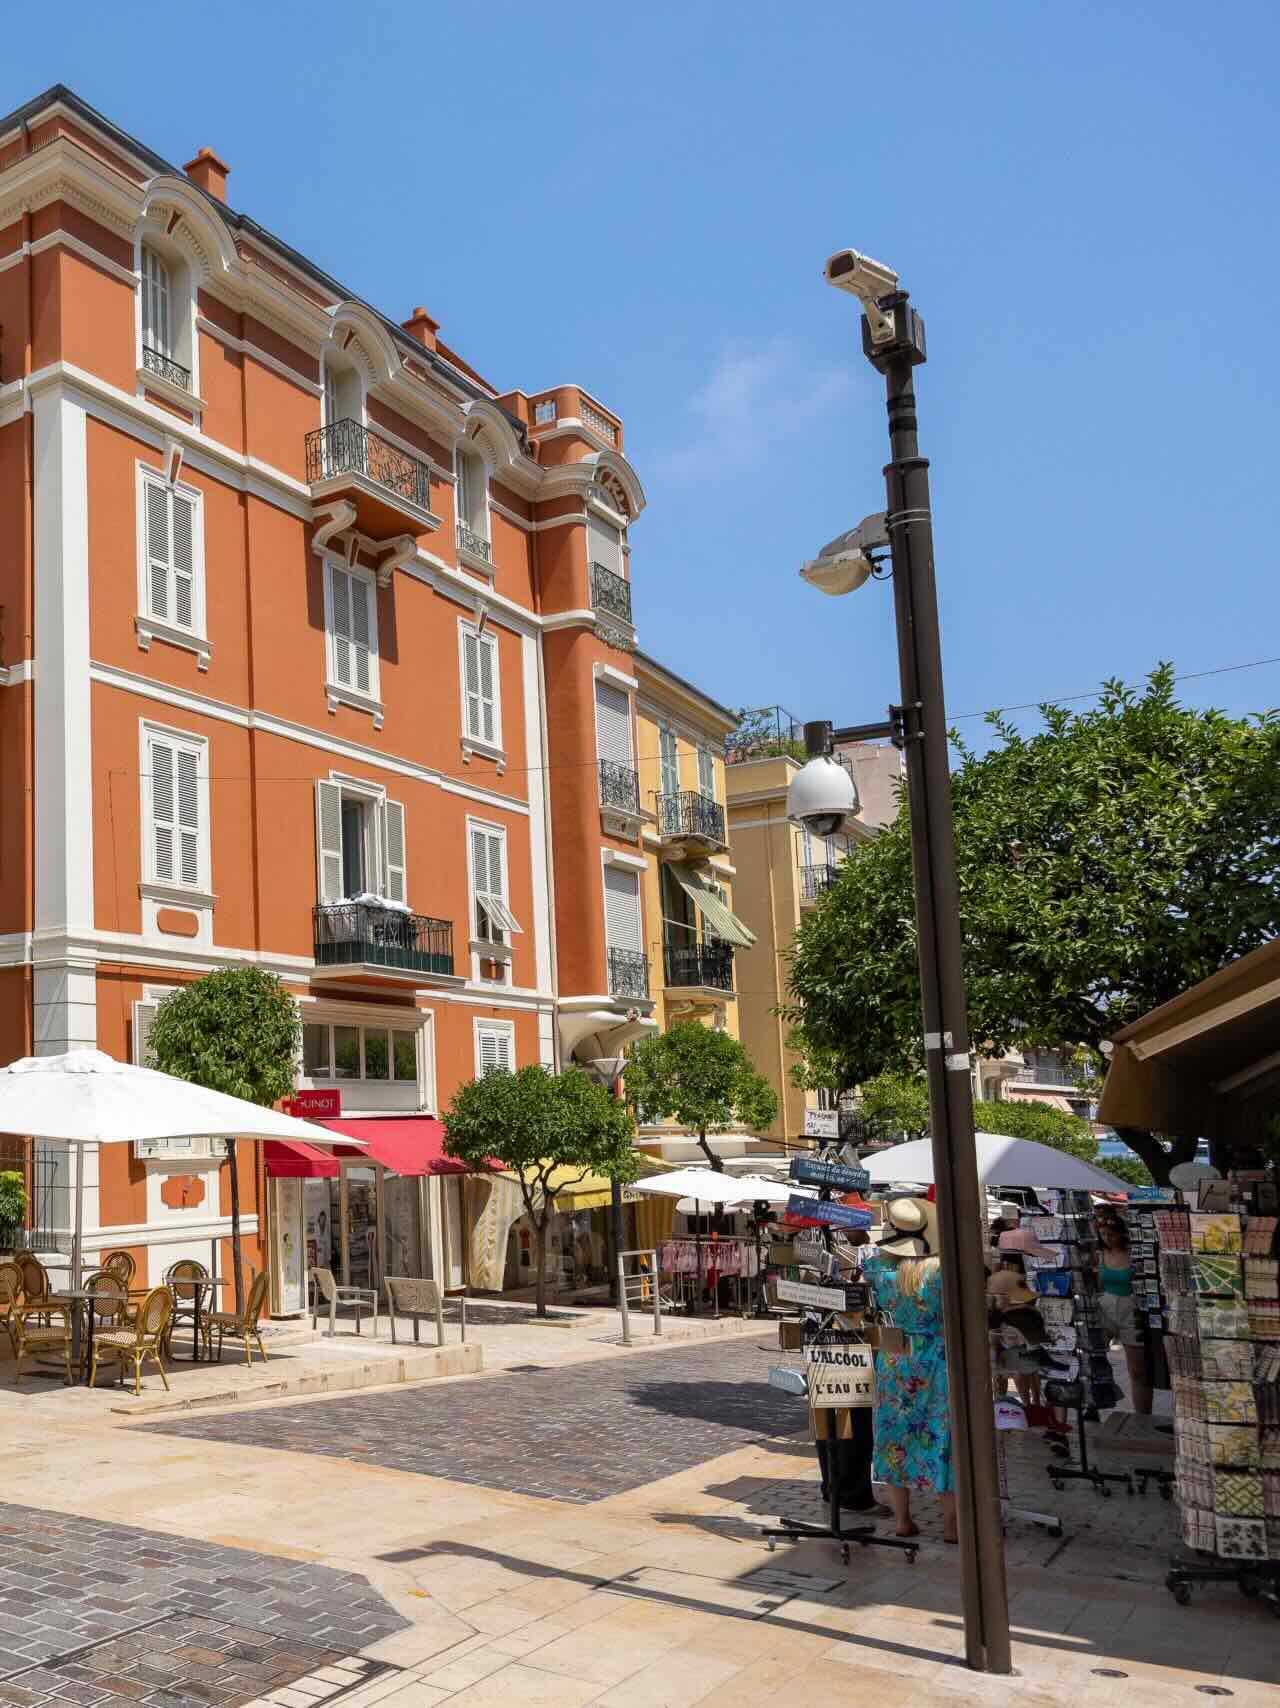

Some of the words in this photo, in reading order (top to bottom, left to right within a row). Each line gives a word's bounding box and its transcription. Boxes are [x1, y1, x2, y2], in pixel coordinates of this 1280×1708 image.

[299, 1098, 335, 1110] UINOT
[811, 1350, 868, 1367] L'ALCOOL
[815, 1383, 851, 1394] L'EAU
[855, 1383, 870, 1394] ET
